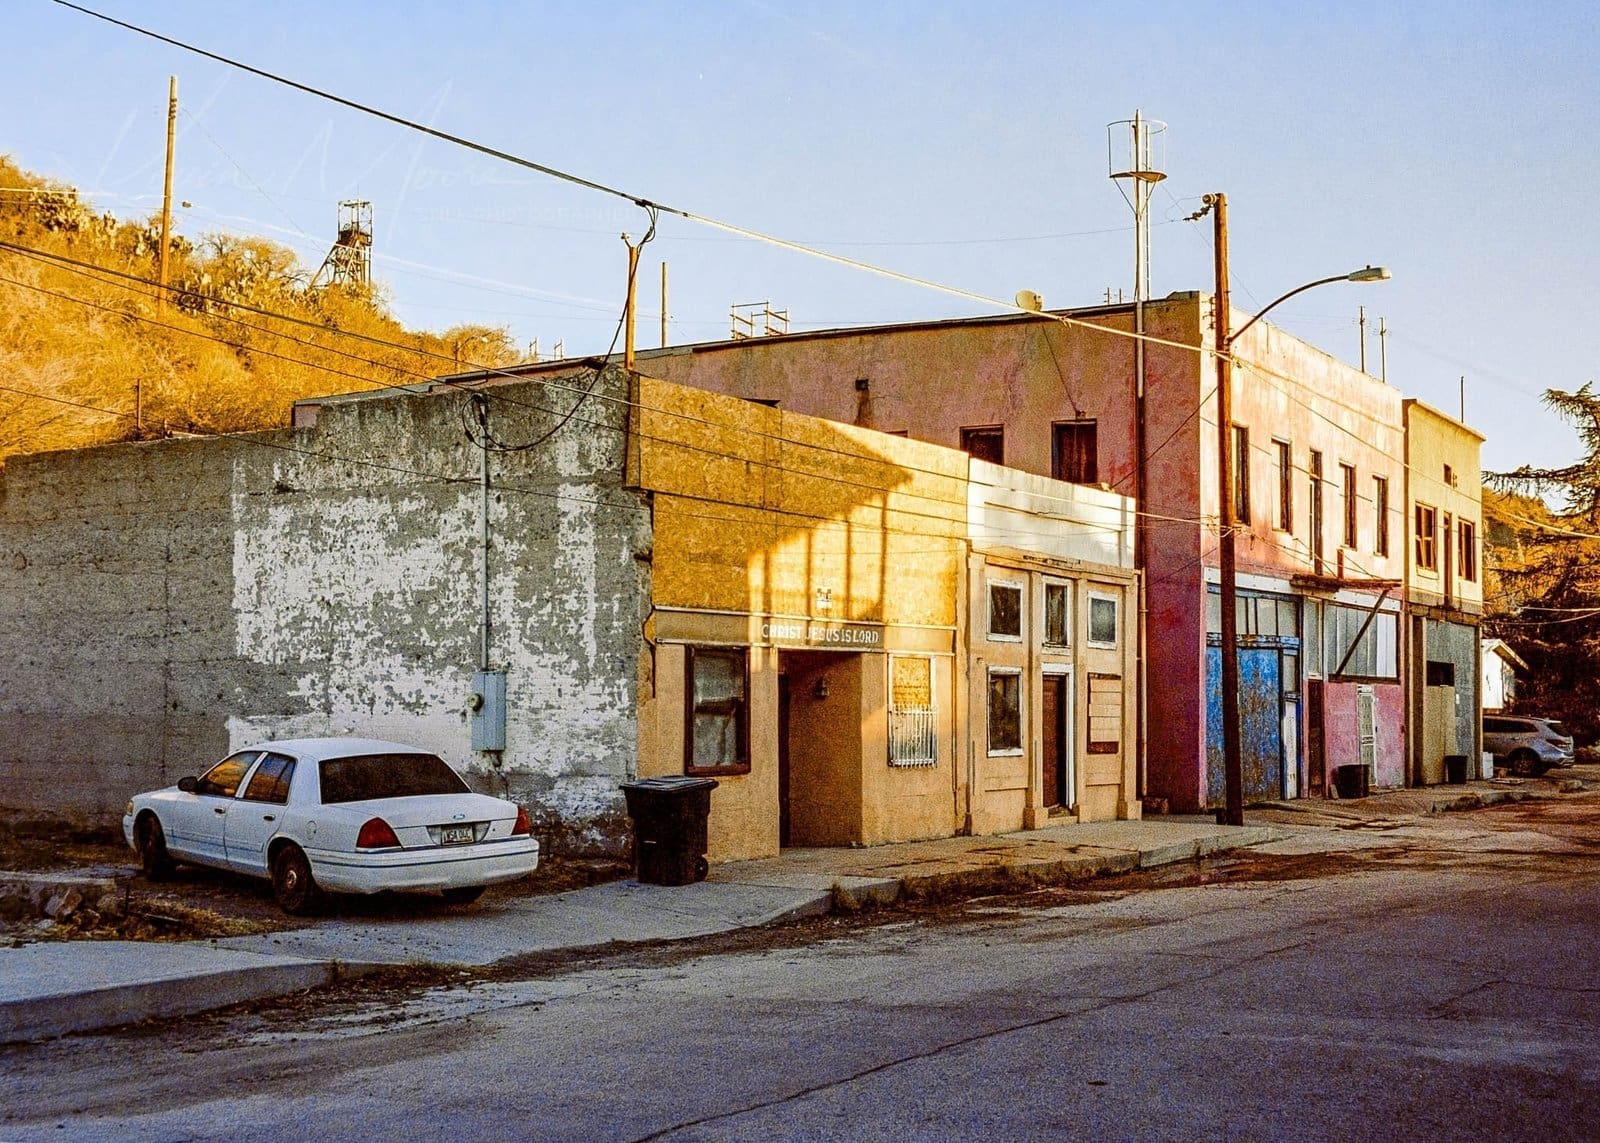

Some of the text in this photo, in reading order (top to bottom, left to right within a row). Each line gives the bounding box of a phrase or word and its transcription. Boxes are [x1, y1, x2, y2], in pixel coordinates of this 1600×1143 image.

[761, 624, 880, 644] CHRIST JESUS IS LORD
